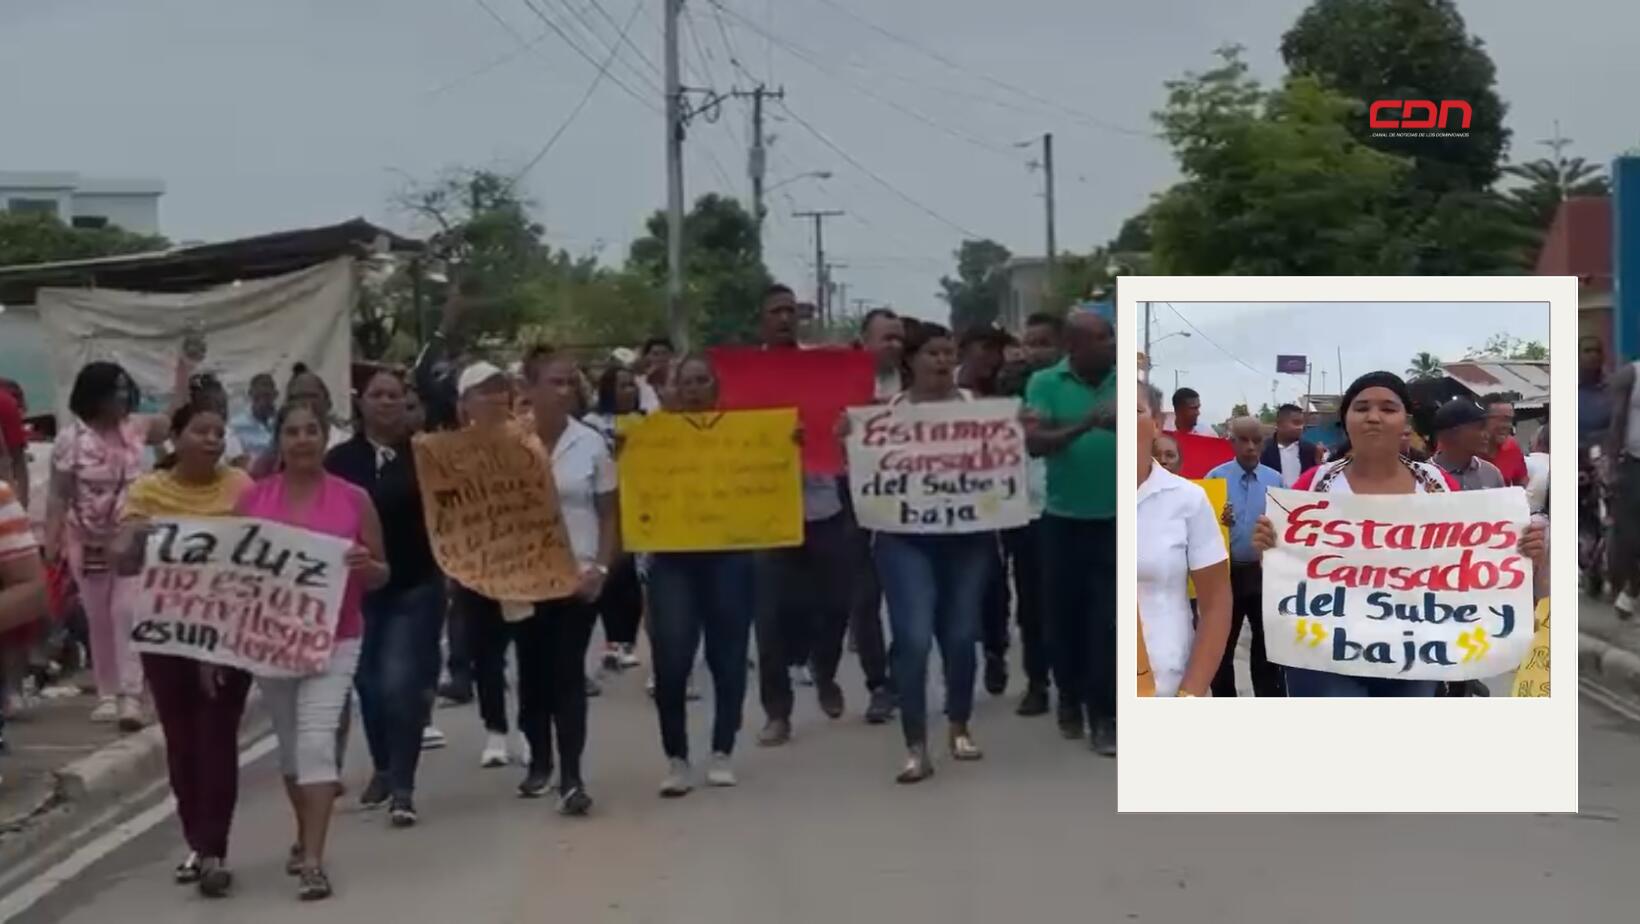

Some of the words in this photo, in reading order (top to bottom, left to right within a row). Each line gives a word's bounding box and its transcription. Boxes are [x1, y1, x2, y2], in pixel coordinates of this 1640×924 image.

[863, 410, 1017, 447] Estamos
[861, 472, 908, 496] del
[1002, 473, 1017, 500] y
[1284, 500, 1519, 550] Estamos
[231, 524, 328, 588] luz
[1278, 580, 1345, 618] del
[1488, 604, 1515, 638] y
